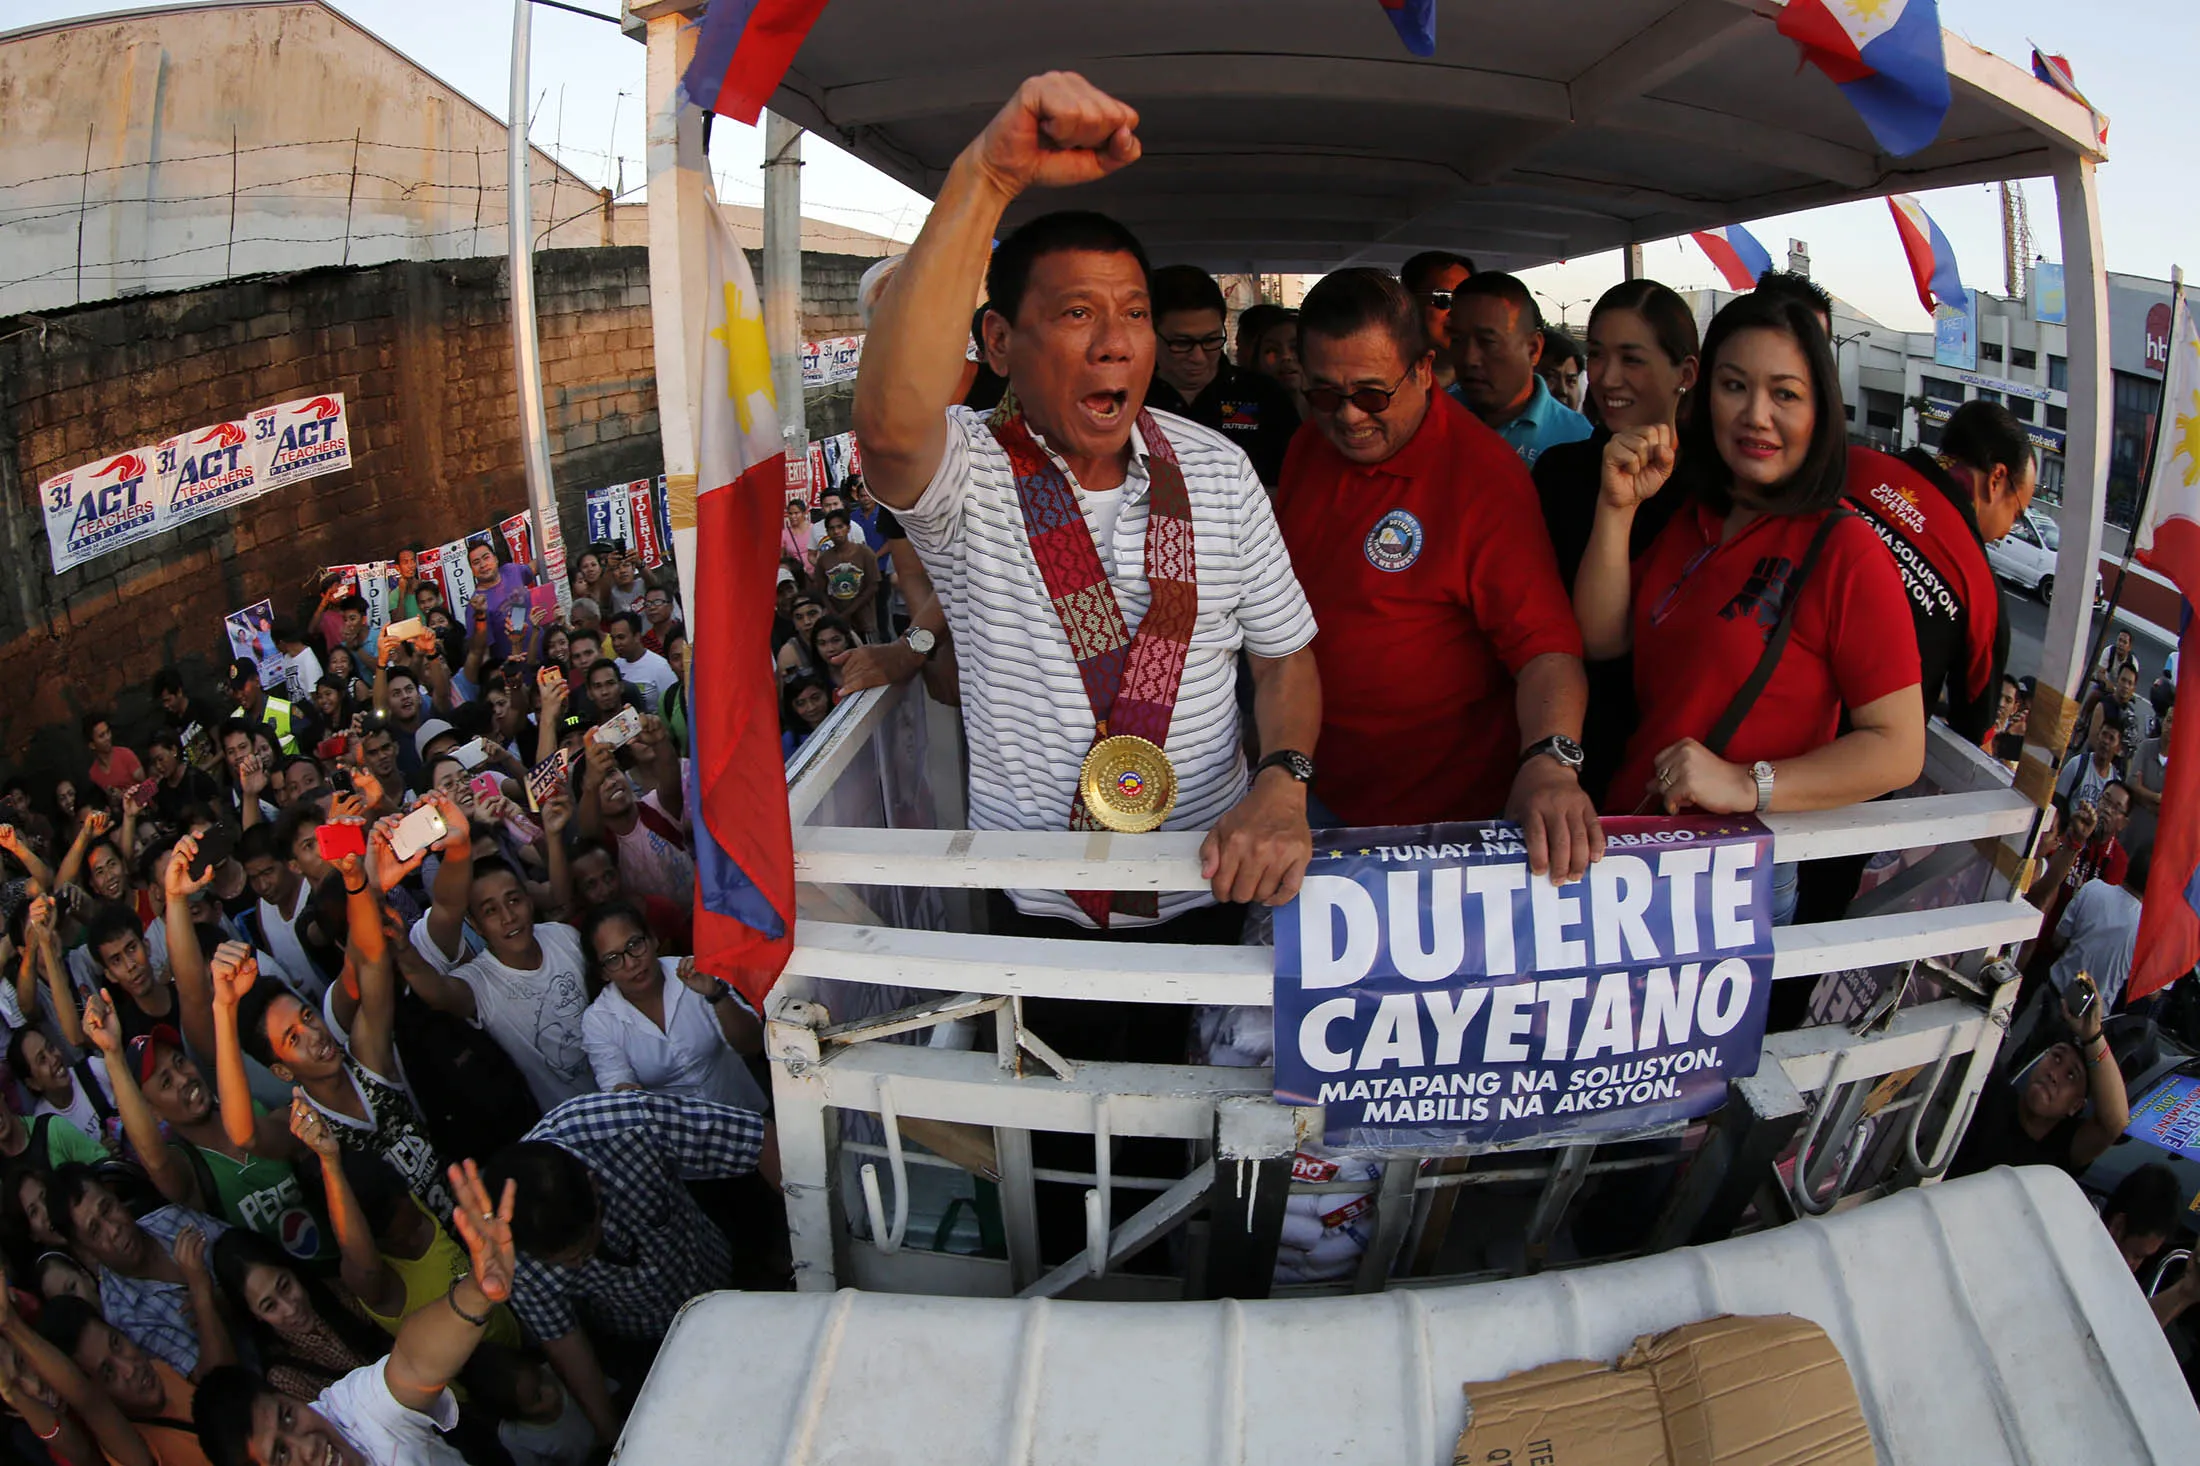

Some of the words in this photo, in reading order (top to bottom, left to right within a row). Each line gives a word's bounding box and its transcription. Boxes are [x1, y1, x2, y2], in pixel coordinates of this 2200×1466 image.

[803, 355, 820, 370] CT
[255, 415, 276, 441] 31
[271, 416, 338, 466] ACT
[2027, 432, 2058, 449] trobank
[156, 447, 177, 475] 31
[280, 438, 345, 463] TEACHERS
[170, 444, 243, 503] ACT
[180, 465, 253, 499] TEACHERS
[49, 482, 73, 513] 31
[68, 475, 144, 541] ACT
[1870, 488, 1923, 533] CAYETANO
[1879, 483, 1926, 524] DUTERTE
[69, 514, 154, 551] PARTYLIST
[77, 500, 154, 537] TEACHERS
[635, 495, 654, 563] TOLENTINO
[1891, 540, 1958, 621] SOLUSYON.
[1900, 567, 1935, 616] SYON.
[1375, 843, 1471, 862] TUNAY
[1483, 842, 1527, 857] NA
[1606, 830, 1696, 848] ABAGO
[1301, 842, 1757, 989] DUTERTE
[1298, 958, 1753, 1073] CAYETANO
[1317, 1070, 1501, 1105] MATAPANG
[1512, 1069, 1558, 1094] NA
[1569, 1046, 1724, 1089] SOLUSYON.
[1362, 1095, 1490, 1123] MABILIS
[1499, 1096, 1544, 1121] NA
[1558, 1076, 1682, 1113] AKSYON.
[2153, 1094, 2181, 1112] 2016
